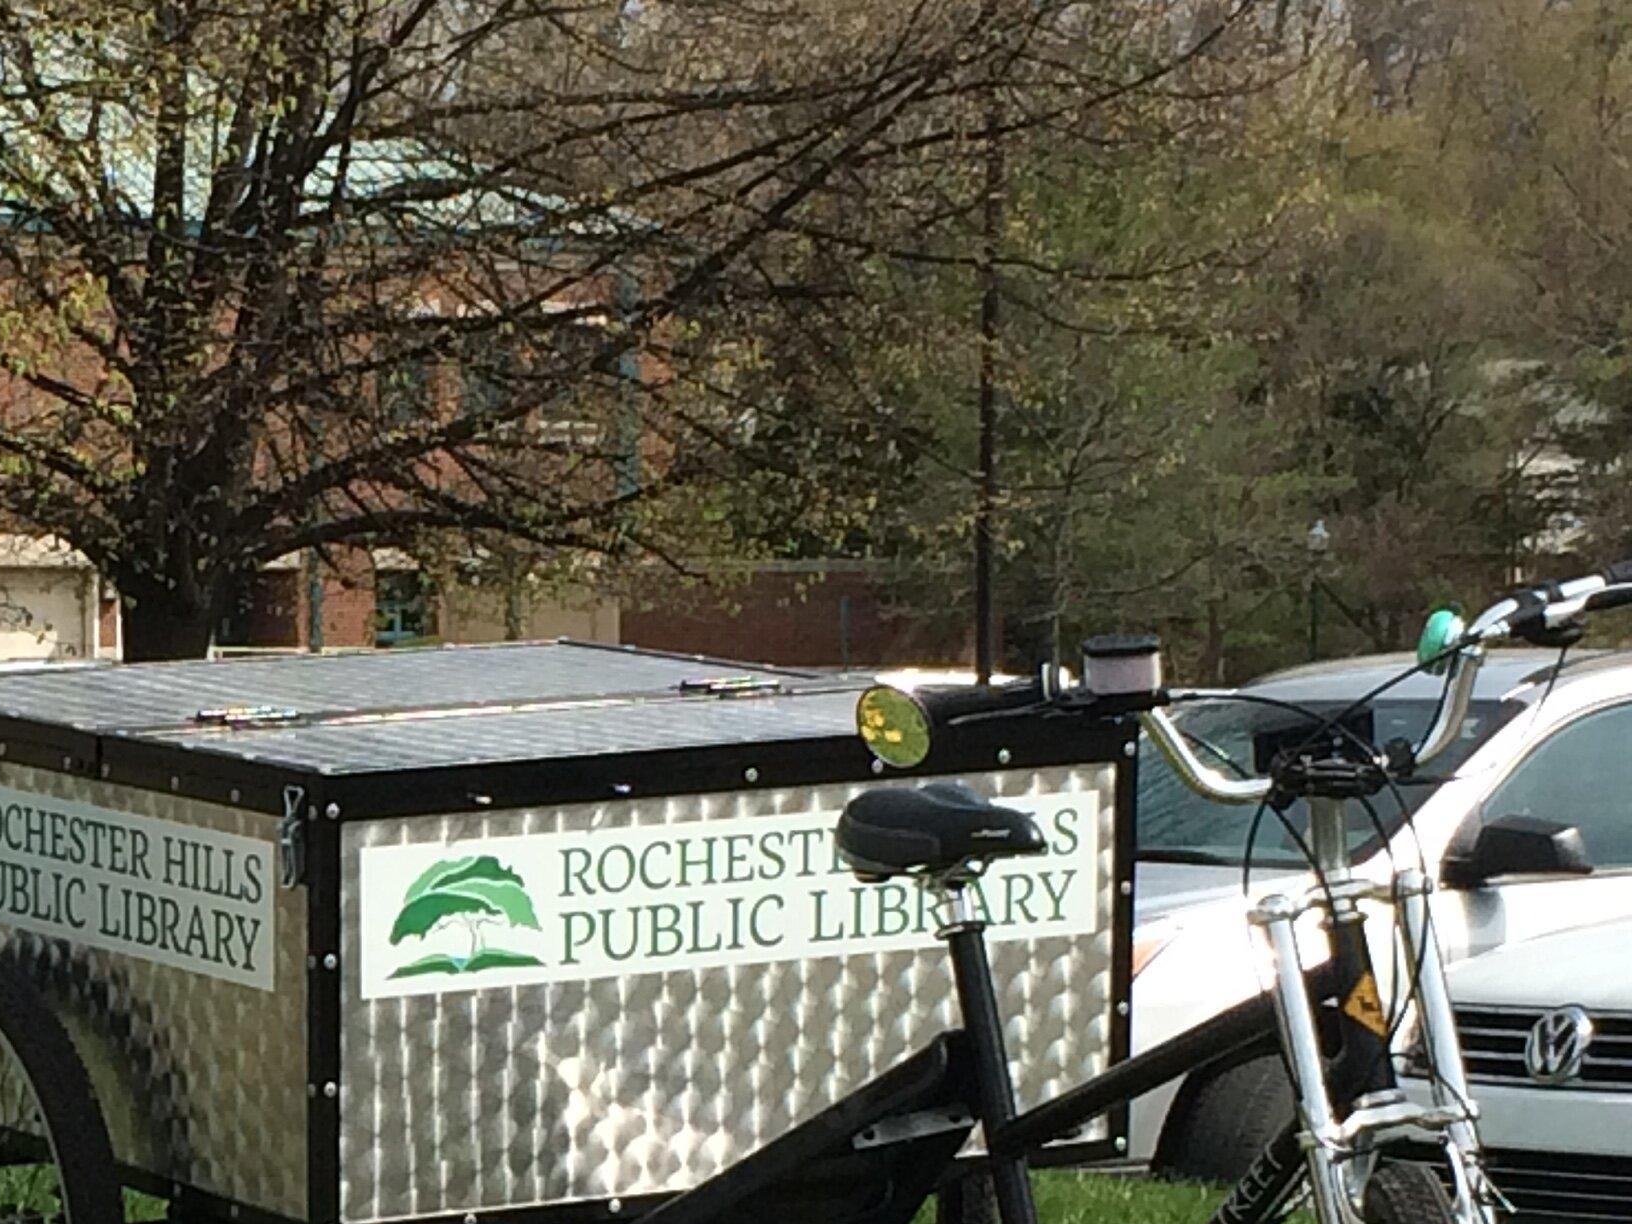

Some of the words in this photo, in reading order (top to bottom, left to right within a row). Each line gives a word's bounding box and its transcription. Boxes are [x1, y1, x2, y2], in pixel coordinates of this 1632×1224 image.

[163, 835, 261, 904] HILLS
[557, 827, 852, 897] ROCHEST
[99, 882, 261, 972] LIBRARY
[558, 893, 784, 966] PUBLIC
